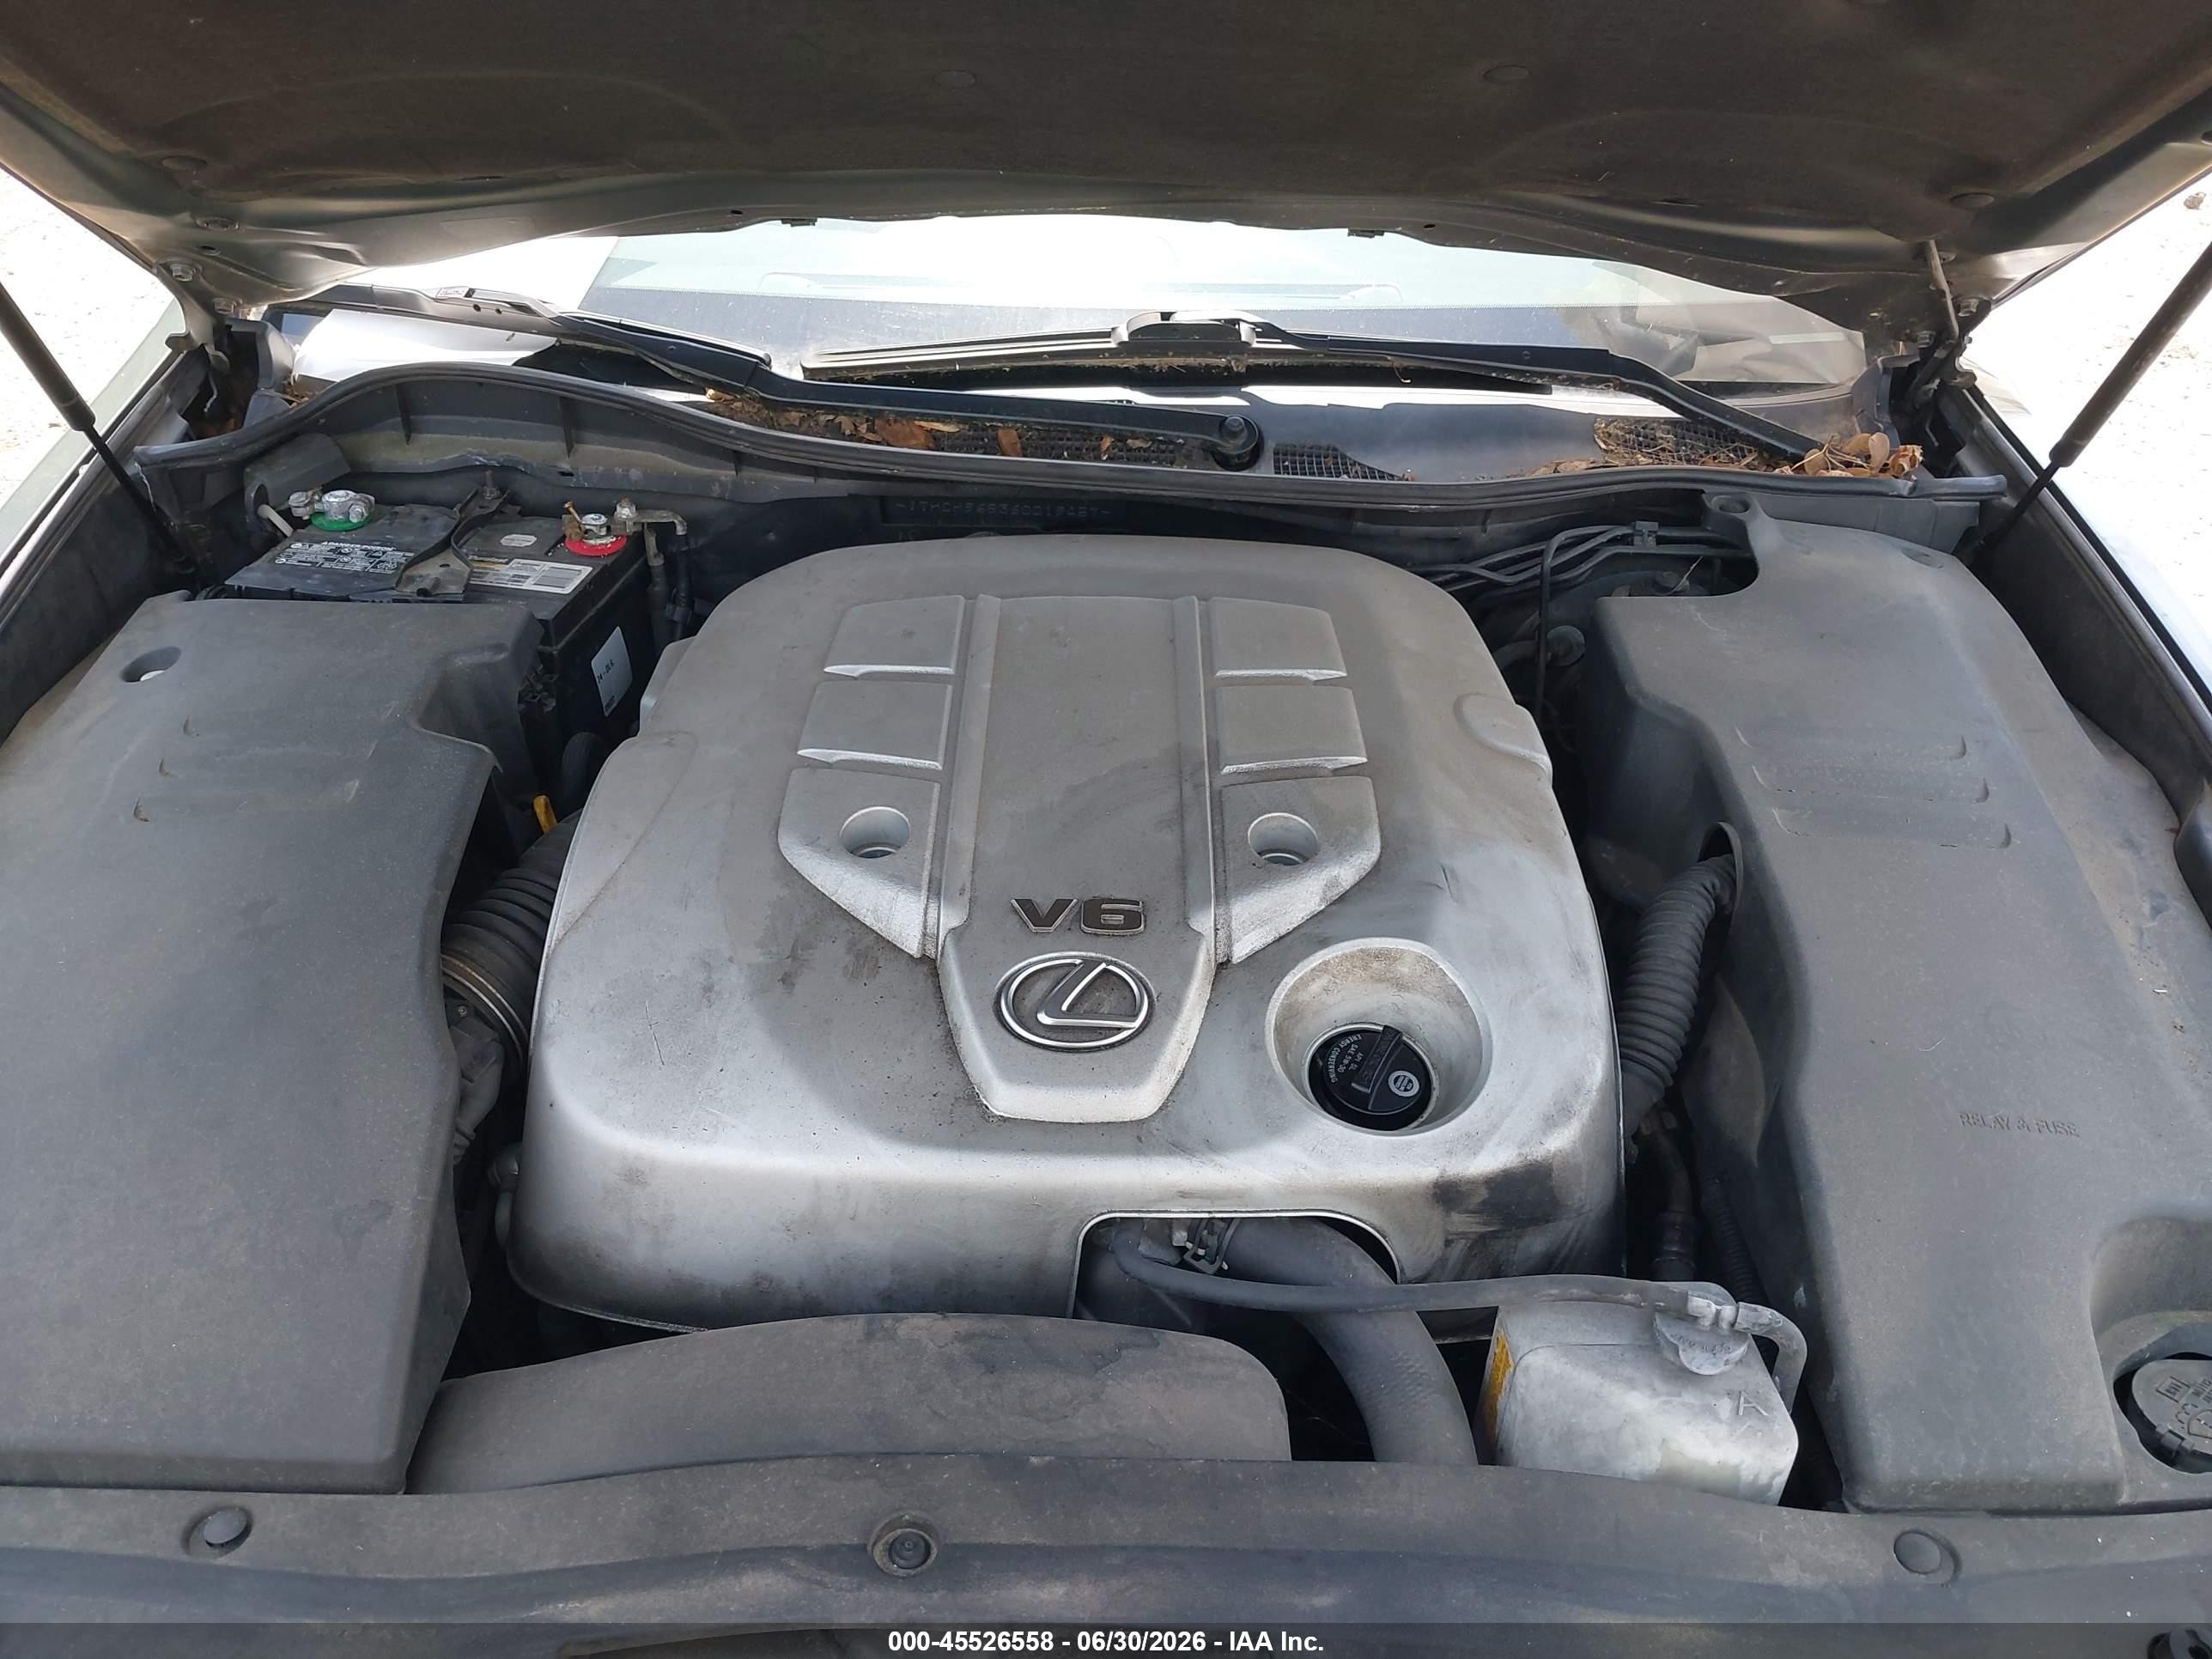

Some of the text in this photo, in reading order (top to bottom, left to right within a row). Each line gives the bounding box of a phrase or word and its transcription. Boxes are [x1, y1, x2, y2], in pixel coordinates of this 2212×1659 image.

[1011, 897, 1145, 935] V6
[1328, 1033, 1362, 1083] ENERGY CONSERVING
[1347, 1043, 1358, 1054] SAE
[1959, 1112, 2080, 1137] RELAY & FUSE
